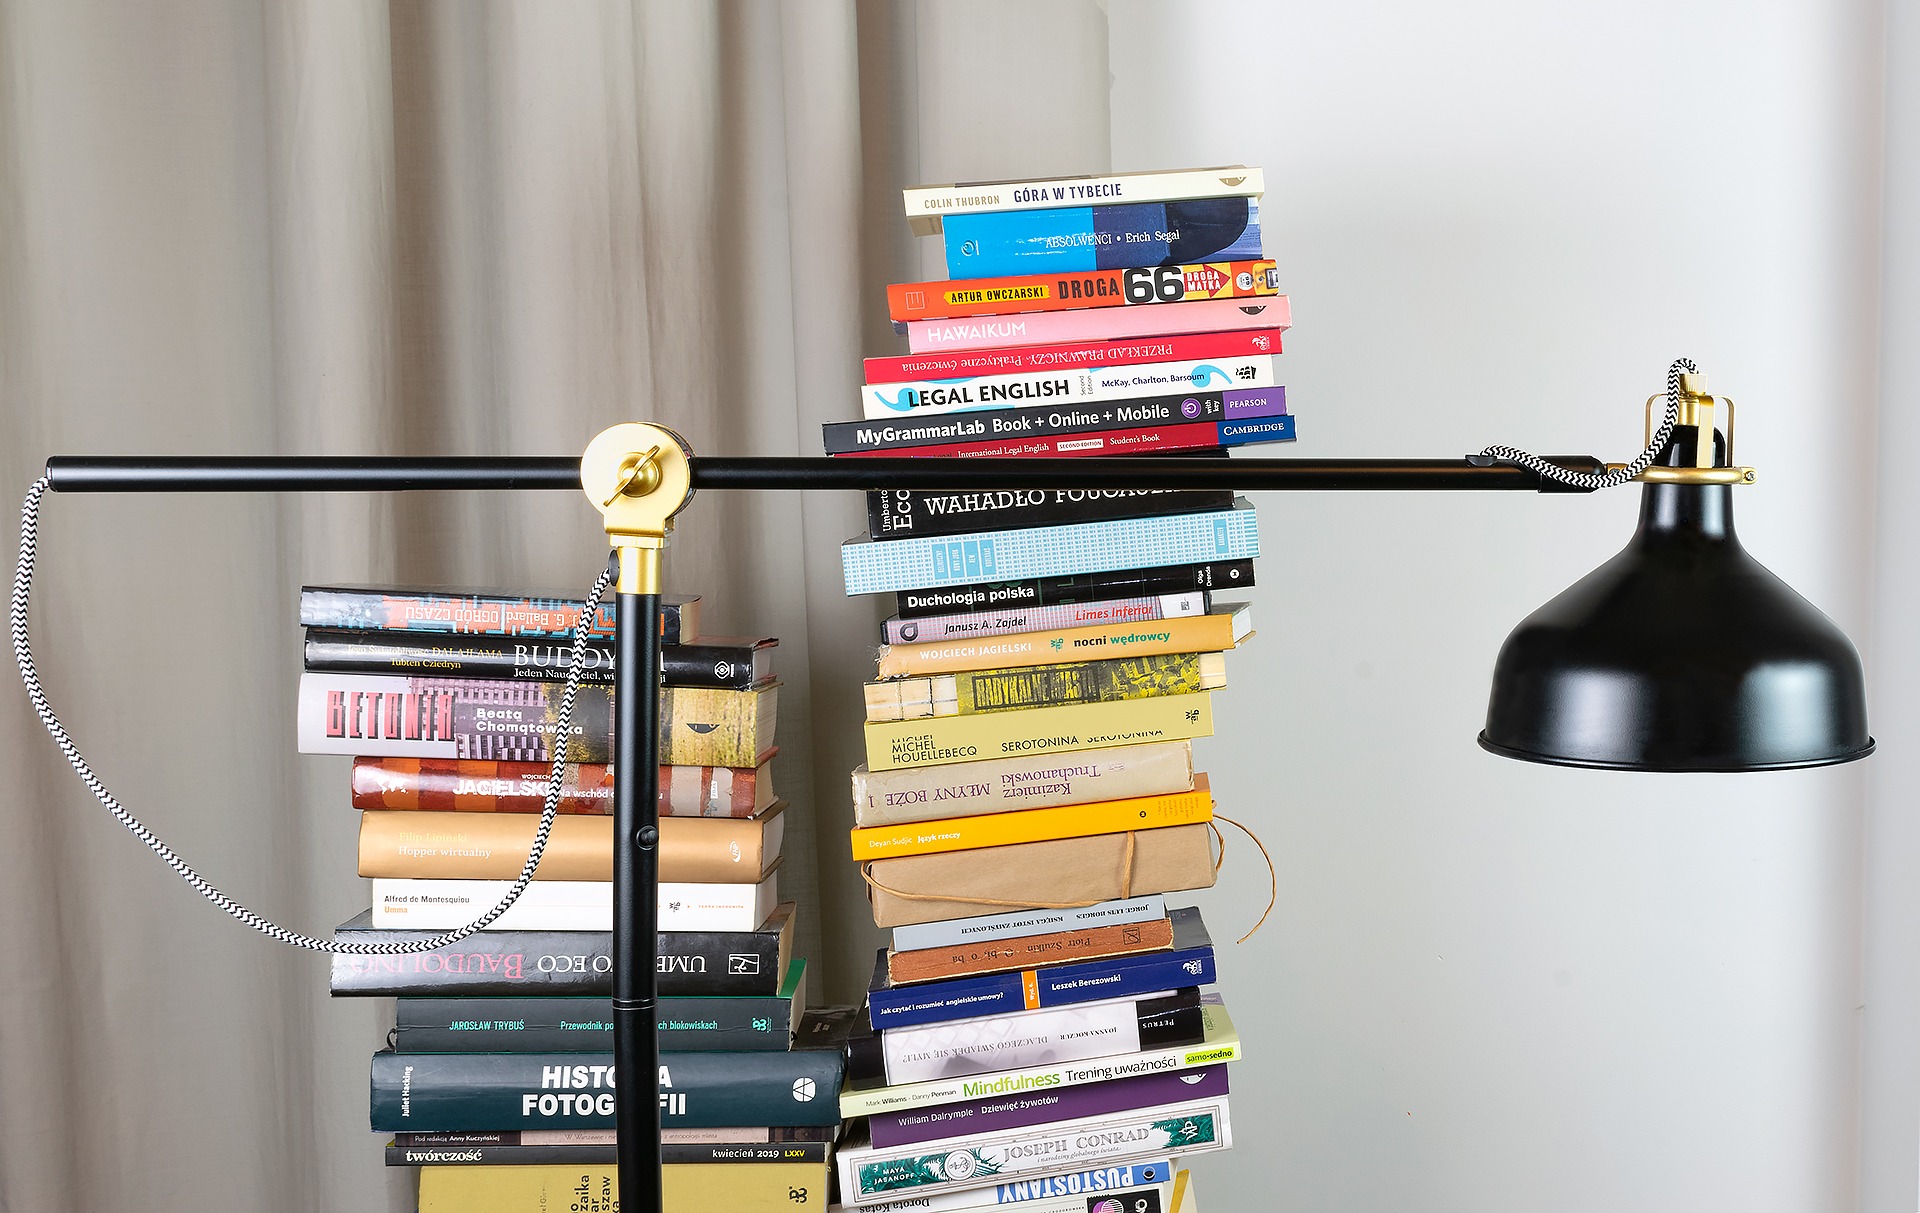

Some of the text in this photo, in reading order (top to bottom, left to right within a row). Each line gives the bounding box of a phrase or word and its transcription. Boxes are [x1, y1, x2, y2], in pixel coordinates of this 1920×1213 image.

[1014, 183, 1123, 203] GÓRA W TYBECIE
[924, 195, 1000, 209] COLIN THUBRON
[1045, 229, 1180, 249] ABSOLWENCI Erich Segal
[1058, 265, 1185, 304] DROGA 66
[1186, 271, 1220, 282] DROGA
[1187, 280, 1221, 292] MATKA
[951, 287, 1044, 303] ARTUR OWCZARSKI
[928, 321, 1027, 343] HAWAIKUM
[902, 344, 1173, 374] PRZEKŁAD Praktyczne ćwiczenia
[1101, 372, 1205, 389] McKay, Charlton, Barsoum
[908, 379, 1069, 408] LEGAL ENGLISH
[1205, 399, 1213, 415] with
[1229, 398, 1267, 408] PEARSON
[856, 419, 985, 445] MyGrammarLab
[992, 415, 1031, 433] Book
[1048, 409, 1100, 428] Online
[1117, 404, 1170, 422] Mobile
[1223, 422, 1285, 436] CAMBRIDGE
[1059, 440, 1102, 450] SECOND EDITION
[1142, 433, 1160, 443] Book
[957, 446, 1002, 458] International
[1003, 445, 1023, 457] Legal
[1023, 443, 1050, 454] English
[882, 489, 892, 532] Umberto
[923, 489, 1046, 516] WAHADŁO
[1205, 565, 1213, 587] Drenda
[907, 586, 1035, 608] Duchologia polska
[405, 607, 499, 626] OGRÓD CZASU
[506, 610, 565, 626] G. Ballard
[1075, 604, 1153, 621] Limes Inferior
[944, 616, 1027, 635] Janusz A. Zajdel
[1073, 634, 1107, 647] nocni
[1110, 631, 1171, 646] wędrowcy
[919, 642, 1032, 660] WOJCIECH JAGIELSKI
[390, 658, 461, 670] Tubten Cziedryn
[513, 668, 543, 678] Jeden
[326, 690, 457, 741] BETONIA
[476, 708, 522, 720] Beata
[892, 740, 936, 754] MICHEL
[1001, 736, 1079, 752] SEROTONINA
[892, 746, 977, 764] HOUELLEBECQ
[521, 773, 551, 781] WOJCIECH
[1001, 764, 1102, 787] Truchanowski
[573, 788, 609, 799] wschód
[884, 782, 991, 807] MŁYNY BOŻE
[1003, 782, 1072, 800] Kazimierz
[399, 831, 468, 845] Filip Lipiński
[869, 831, 961, 849] Deyan Sudjic Język rzeczy
[398, 845, 492, 860] Hopper wirtualny
[384, 895, 470, 905] Alfred de Montesquiou
[384, 906, 408, 914] Umma
[1076, 903, 1150, 920] JORGE LUIS BORGES
[1012, 919, 1035, 929] ISTOT
[1036, 915, 1064, 926] KSIĘGA
[1027, 937, 1091, 953] Piotr Szulkin
[537, 954, 588, 974] ECO
[952, 954, 965, 964] ba
[1051, 973, 1121, 991] Leszek Berezowski
[880, 991, 1004, 1015] Jak czytać rozumieć angielskie umowy?
[449, 1018, 525, 1031] JAROSŁAW TRYBUŚ
[560, 1020, 603, 1031] Przewodnik
[604, 1023, 614, 1032] po
[669, 1020, 718, 1031] blokowiskach
[1142, 1018, 1175, 1029] PETRUS
[1060, 1026, 1117, 1041] JOANNA KOCZUR
[933, 1036, 1049, 1058] DLACZEGO ŚWIADEK SIĘ
[1186, 1049, 1233, 1063] samo-sedno
[963, 1055, 1177, 1098] Mindfulness Trening uważności
[401, 1065, 414, 1118] Juliet Hacking
[865, 1089, 957, 1107] Mark Williams Danny Penman
[898, 1095, 1059, 1127] William Dalrymple Dziewięć żywotów
[414, 1133, 501, 1144] Pod redakcję Anny Kuczyńskiej
[1003, 1138, 1068, 1163] JOSEPH
[1075, 1126, 1150, 1150] CONRAD
[405, 1149, 483, 1163] twórczość
[712, 1149, 806, 1159] kwiecień 2019 LXXV
[1041, 1148, 1100, 1163] narodziny globalnego
[873, 1172, 915, 1186] JASANOFF
[882, 1166, 906, 1176] MAYA
[574, 1174, 590, 1211] zaika
[1001, 1165, 1134, 1204] PUSTOSTANY
[601, 1175, 612, 1212] szaw
[859, 1198, 930, 1213] Dorota Kotas
